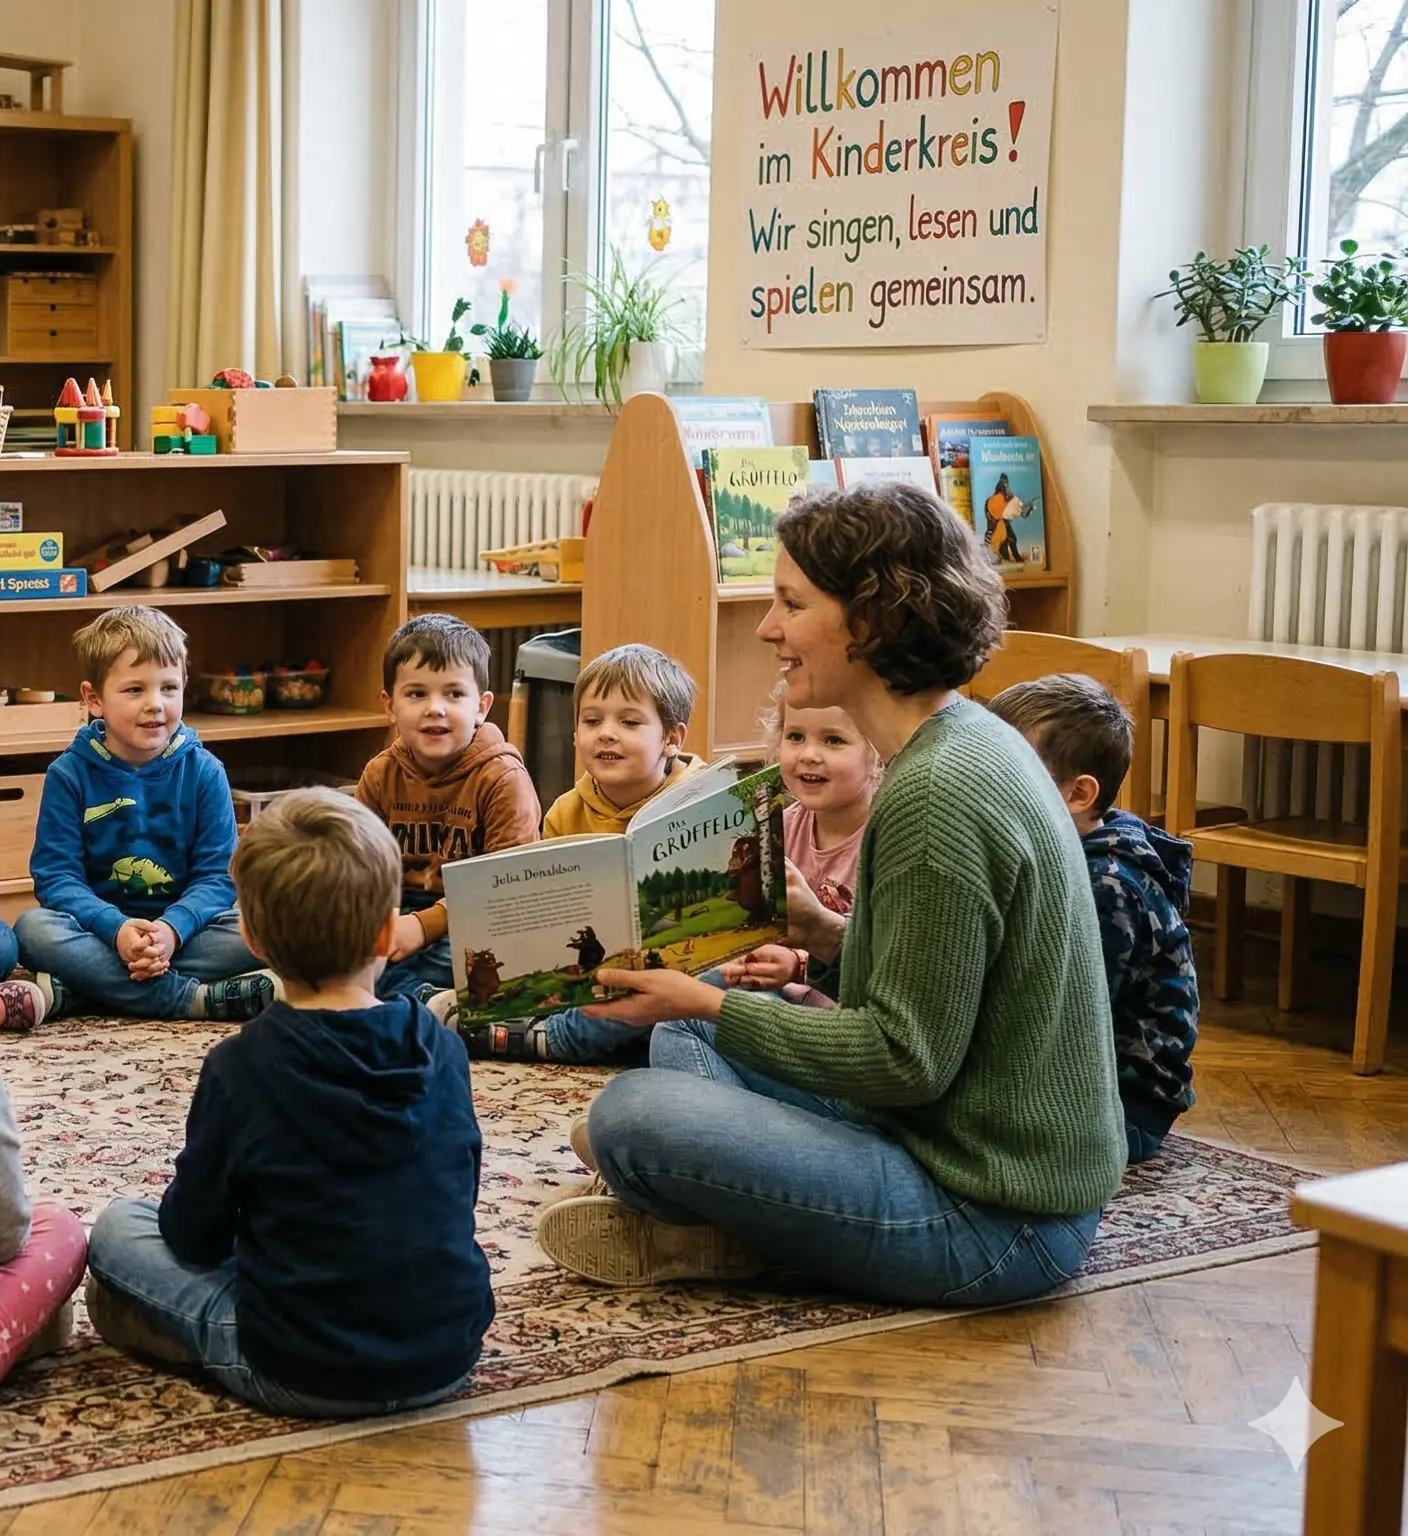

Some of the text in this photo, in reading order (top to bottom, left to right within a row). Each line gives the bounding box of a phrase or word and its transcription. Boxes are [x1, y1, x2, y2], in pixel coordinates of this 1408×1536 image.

[758, 47, 1000, 119] Willkommen
[758, 142, 791, 185] im
[749, 186, 1038, 263] Wir singen, lesen und
[751, 266, 1035, 334] spielen gemeinsam.
[653, 809, 745, 862] GRUFFELO
[492, 872, 520, 888] Julia
